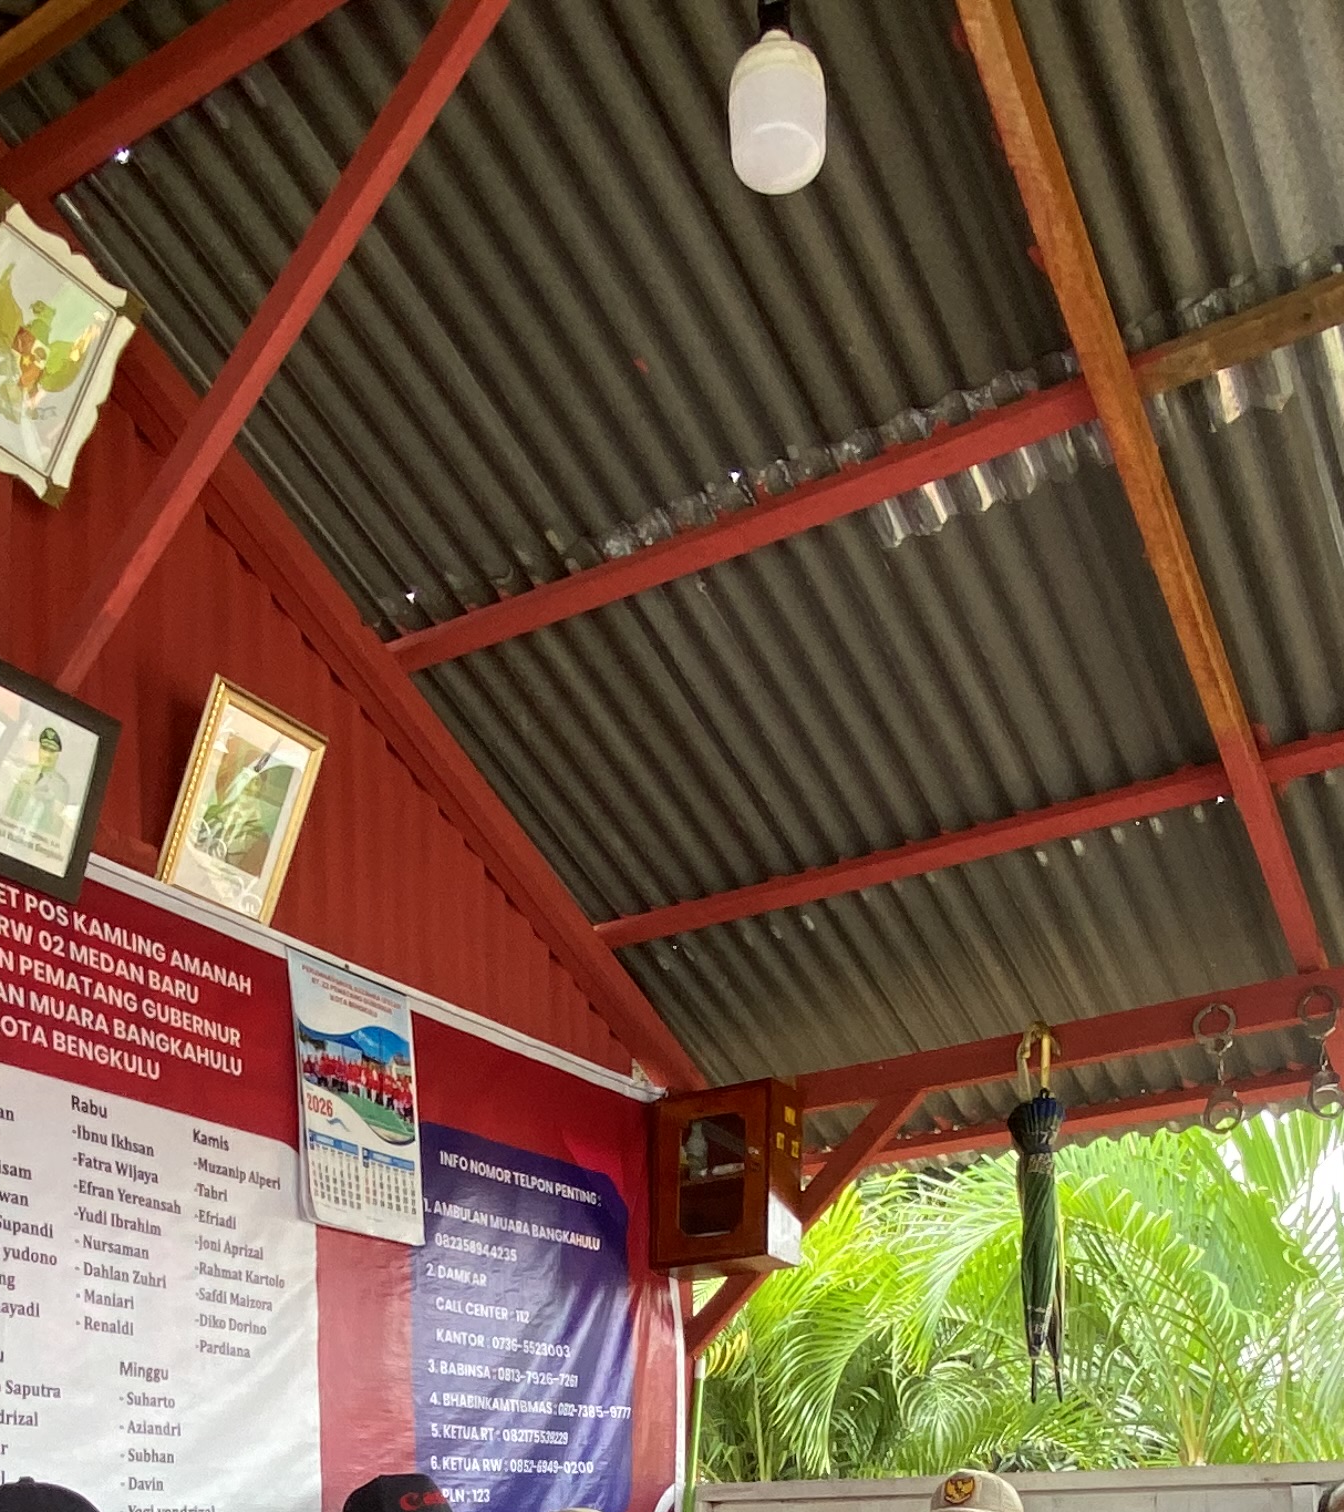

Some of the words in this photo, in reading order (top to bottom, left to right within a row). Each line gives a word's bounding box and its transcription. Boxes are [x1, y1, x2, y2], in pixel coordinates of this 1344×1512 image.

[25, 893, 69, 927] POS
[74, 908, 166, 964] KAMLING
[169, 950, 252, 996] AMANAH
[38, 929, 64, 957] 02
[69, 941, 145, 988] MEDAN
[148, 971, 199, 1004] BARU
[19, 957, 137, 1014] PEMATANG
[142, 997, 242, 1049] GUBERNUR
[29, 991, 109, 1035] MUARA
[113, 1017, 243, 1077] BANGKAHULU
[53, 1028, 161, 1081] BENGKULU
[71, 1094, 107, 1119] Rabu
[111, 1133, 155, 1157] Ikhsan
[192, 1128, 229, 1151] Kamis
[115, 1160, 159, 1184] Wijaya
[439, 1150, 468, 1171] INFO
[470, 1158, 512, 1185] NOMOR
[513, 1172, 554, 1195] TELPON
[433, 1199, 488, 1227] AMBULAN
[490, 1214, 531, 1236] MUARA
[532, 1222, 601, 1251] BANGKAHULU
[3, 1243, 58, 1267] yudono
[437, 1264, 487, 1287] DAMKAR
[435, 1297, 463, 1313] CALL
[465, 1302, 509, 1321] CENTER
[119, 1361, 169, 1382] Minggu
[5, 1379, 61, 1400] Saputra
